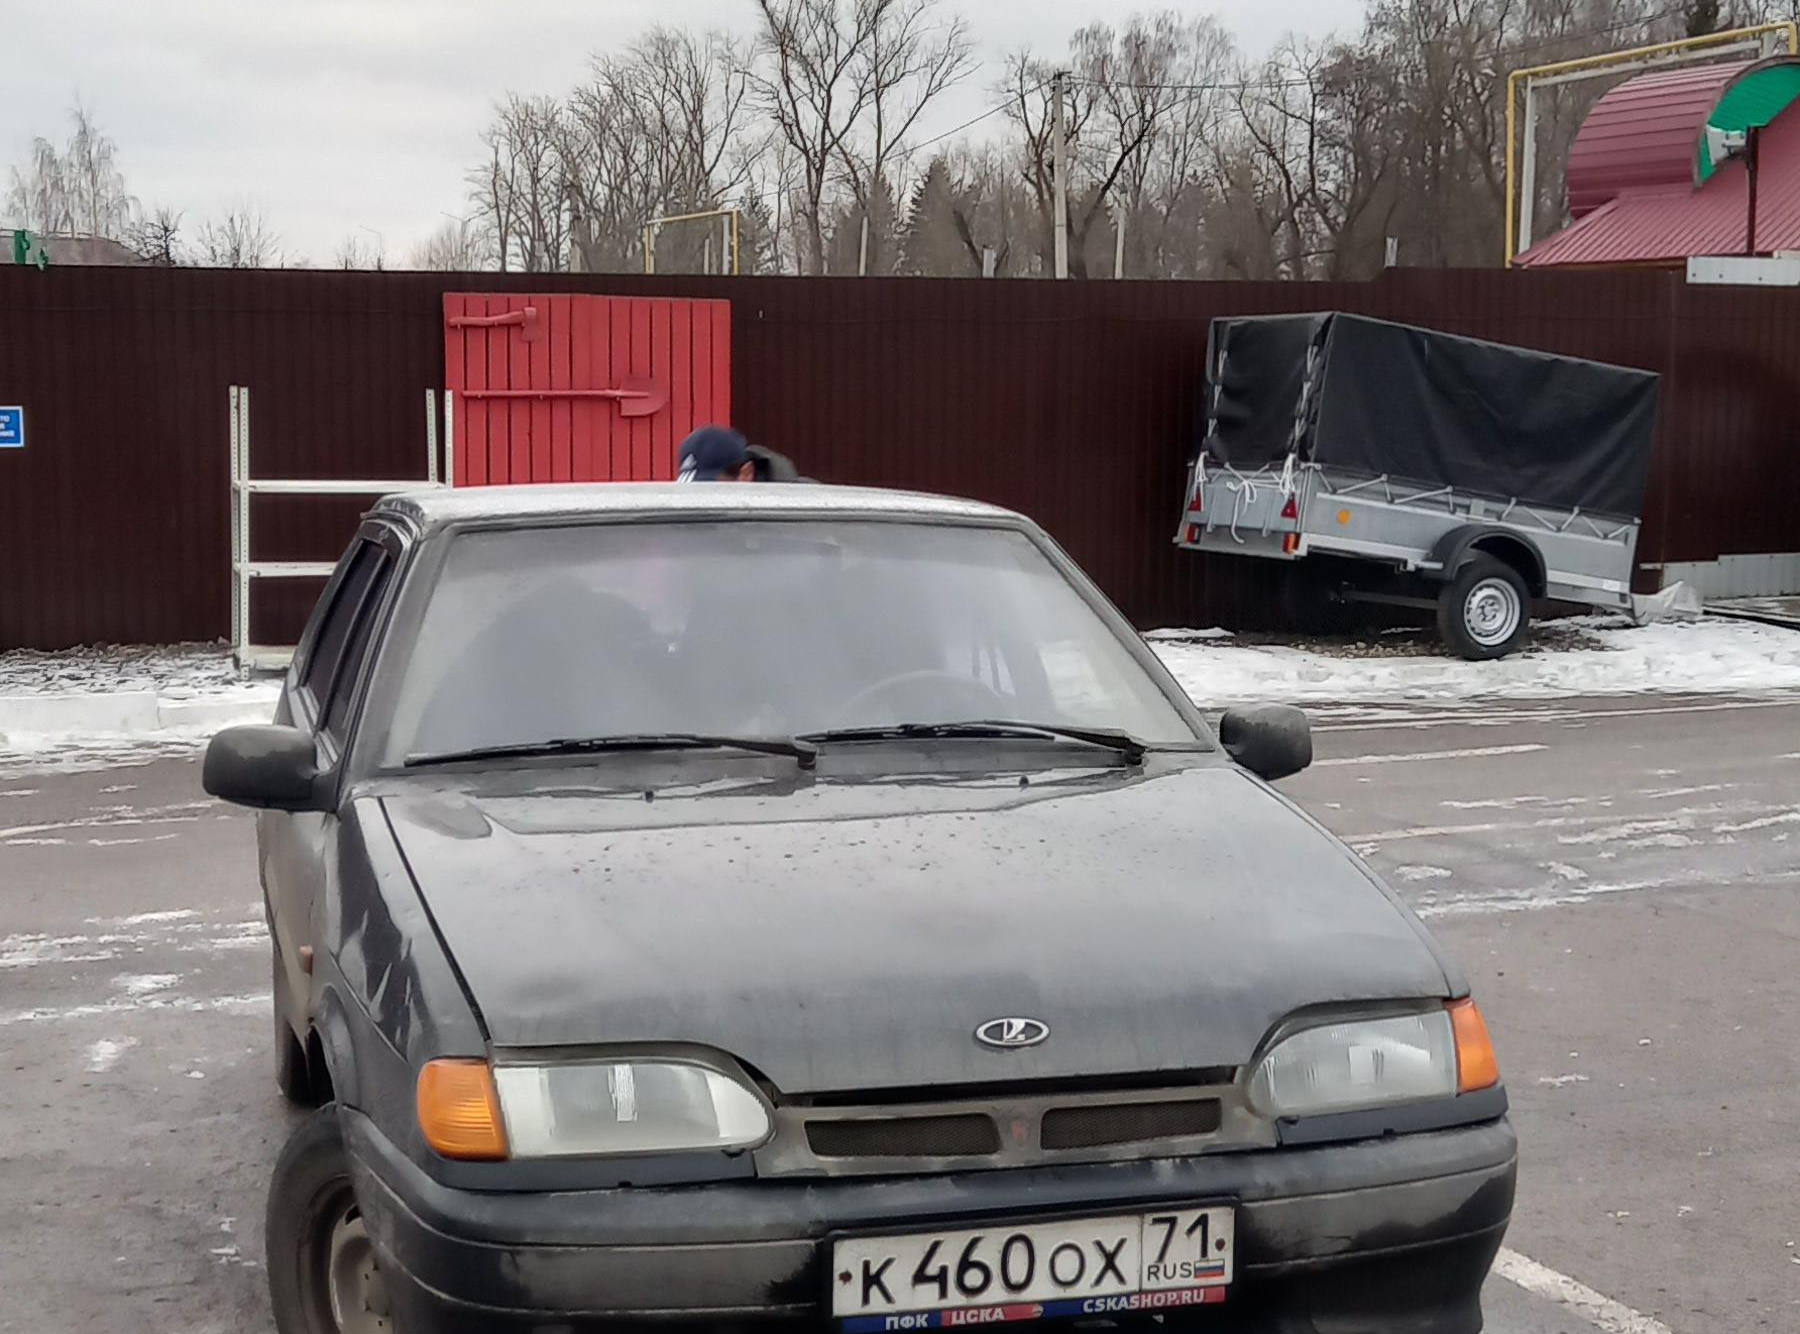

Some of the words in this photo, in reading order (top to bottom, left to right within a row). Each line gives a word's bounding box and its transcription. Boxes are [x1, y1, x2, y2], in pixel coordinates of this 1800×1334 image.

[1150, 1213, 1209, 1263] 71
[1146, 1261, 1192, 1282] RUS
[1083, 1289, 1205, 1314] CSKASHOP.RU
[885, 1313, 929, 1330] ПФК
[950, 1306, 1005, 1326] ЦСКА
